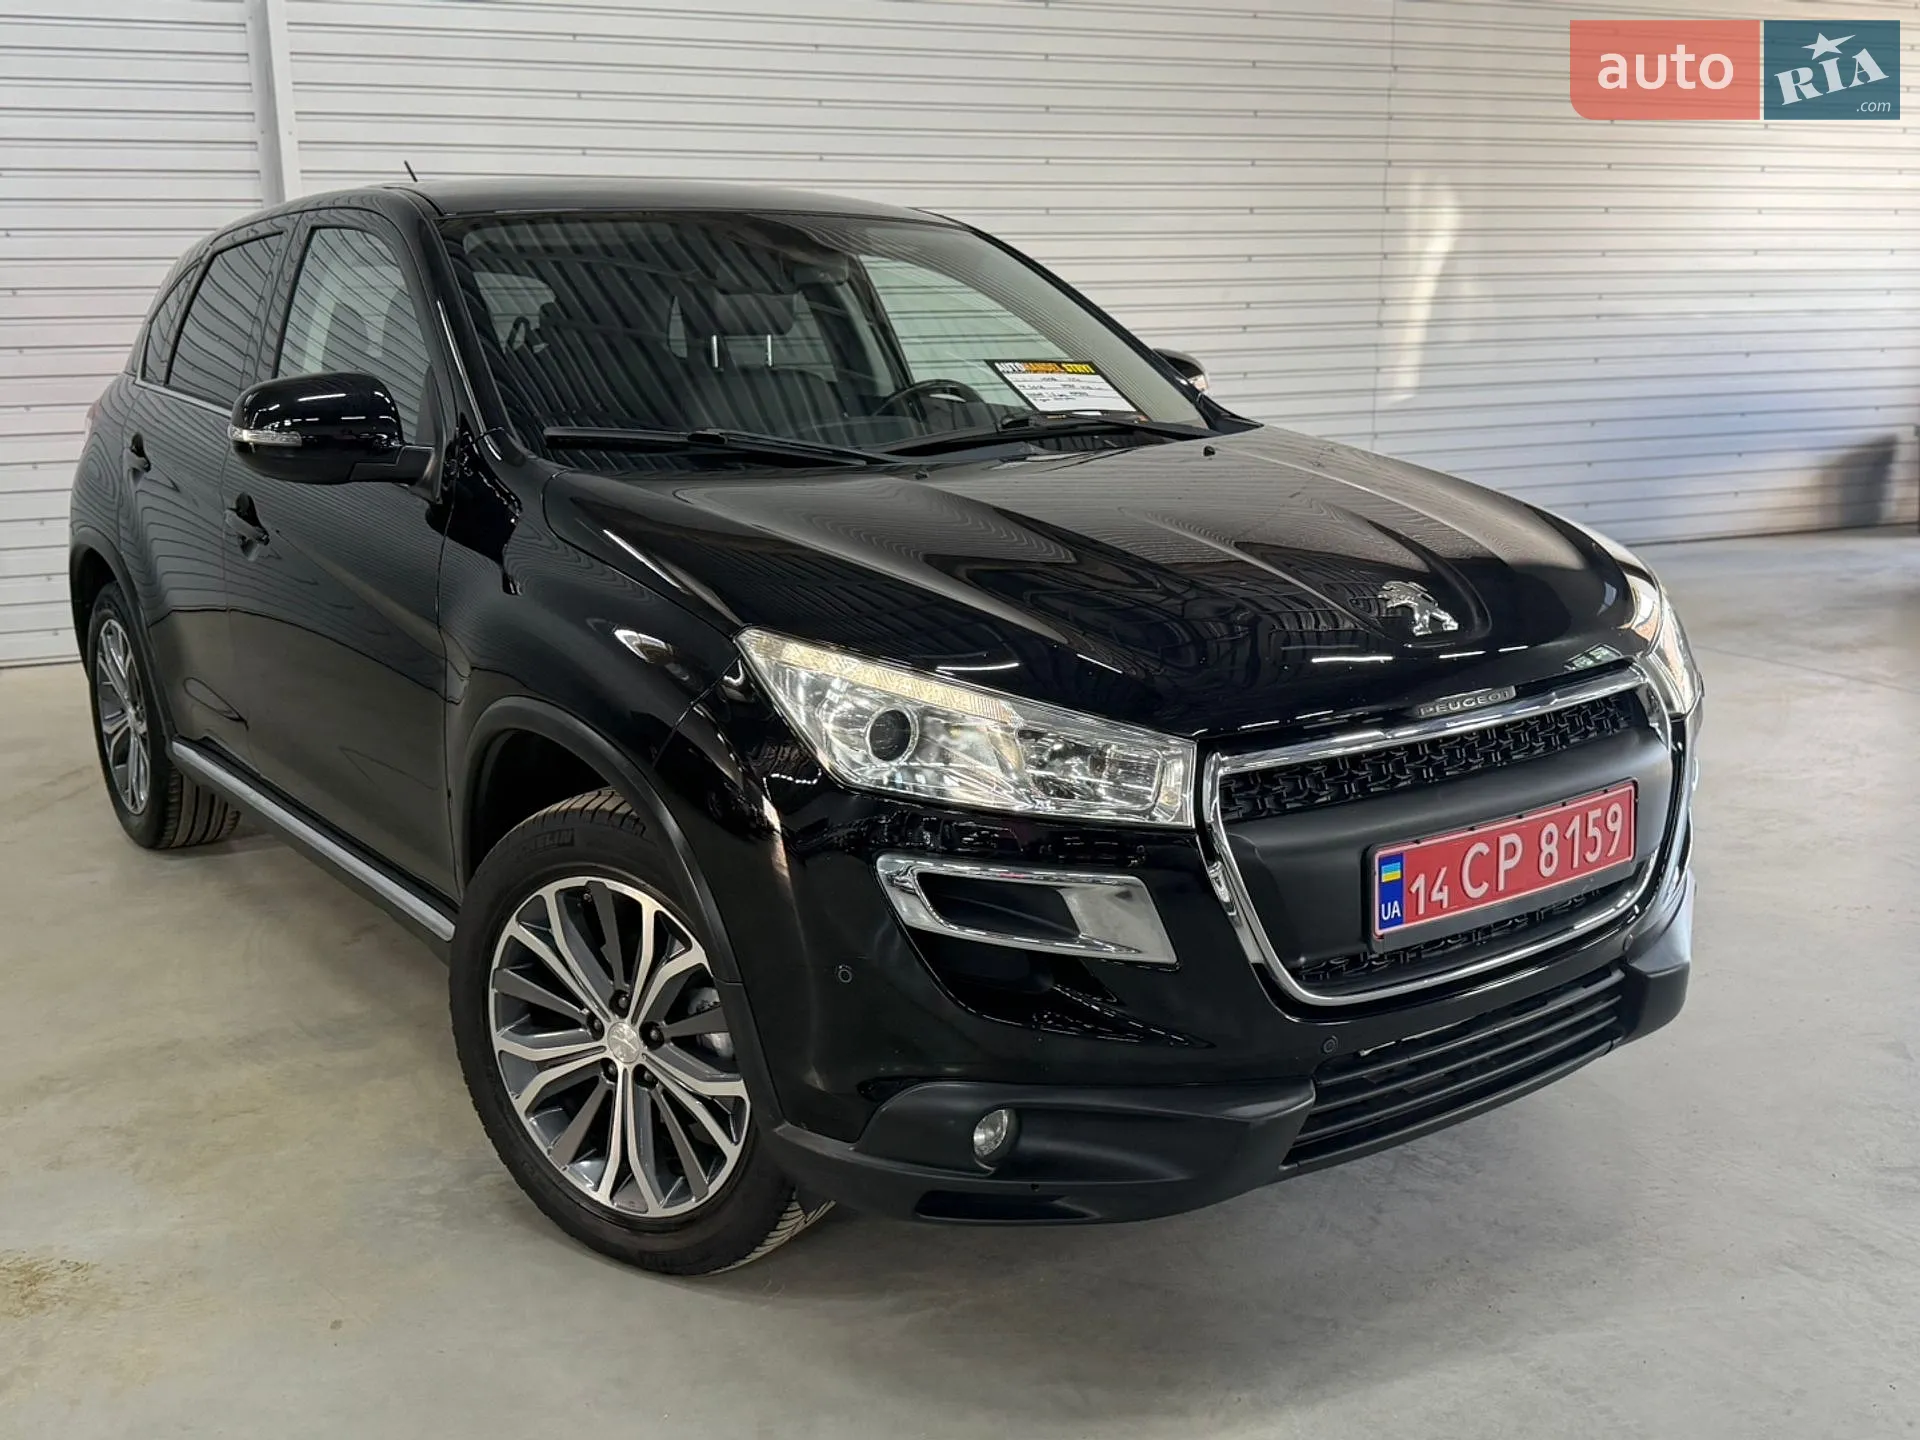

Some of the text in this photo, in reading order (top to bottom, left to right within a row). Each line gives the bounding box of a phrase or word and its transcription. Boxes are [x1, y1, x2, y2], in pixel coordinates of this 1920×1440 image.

[1419, 689, 1510, 716] PEUGEOT
[1409, 802, 1623, 915] 14 CP 8159
[1381, 901, 1402, 921] UA
